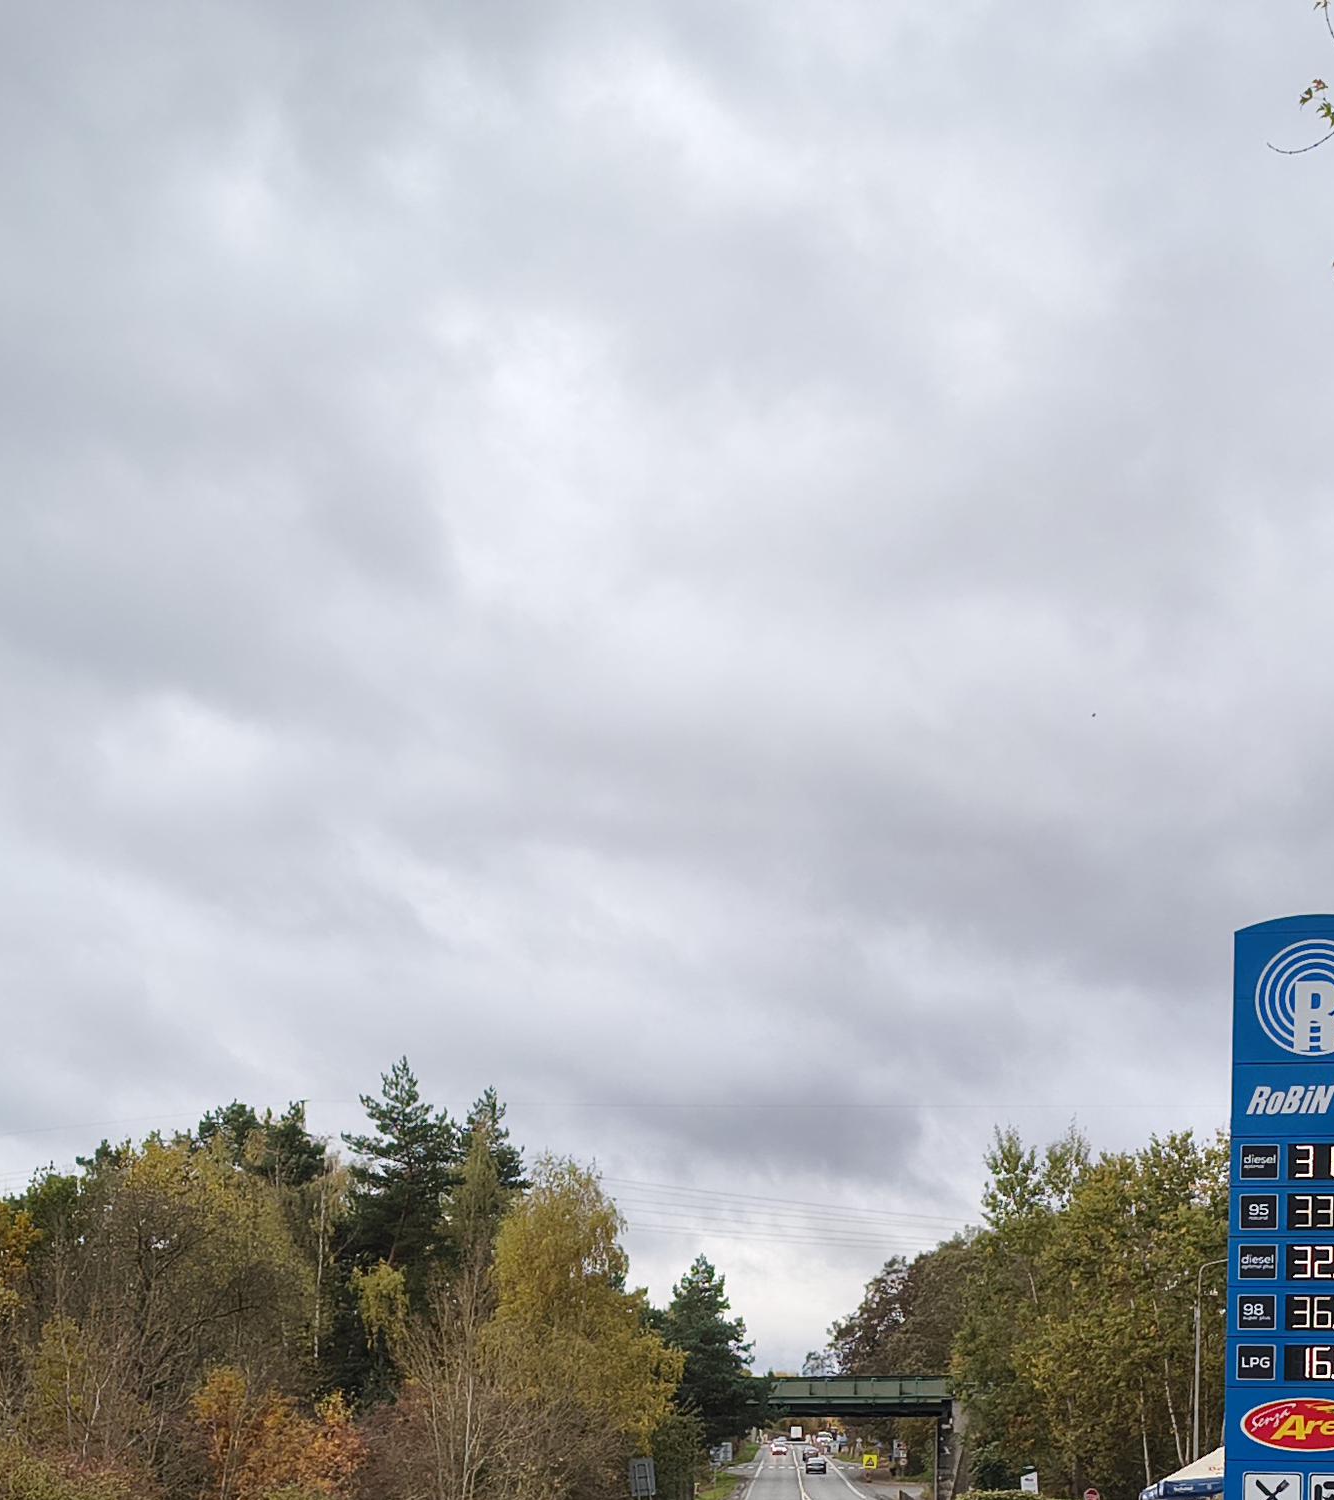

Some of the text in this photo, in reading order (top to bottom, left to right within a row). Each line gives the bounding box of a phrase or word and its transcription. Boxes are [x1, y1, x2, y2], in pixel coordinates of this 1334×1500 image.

[1243, 1154, 1276, 1164] diesel
[1248, 1203, 1269, 1216] 95
[1241, 1254, 1274, 1264] diesel
[1243, 1303, 1265, 1316] 98
[1241, 1356, 1271, 1368] LPG
